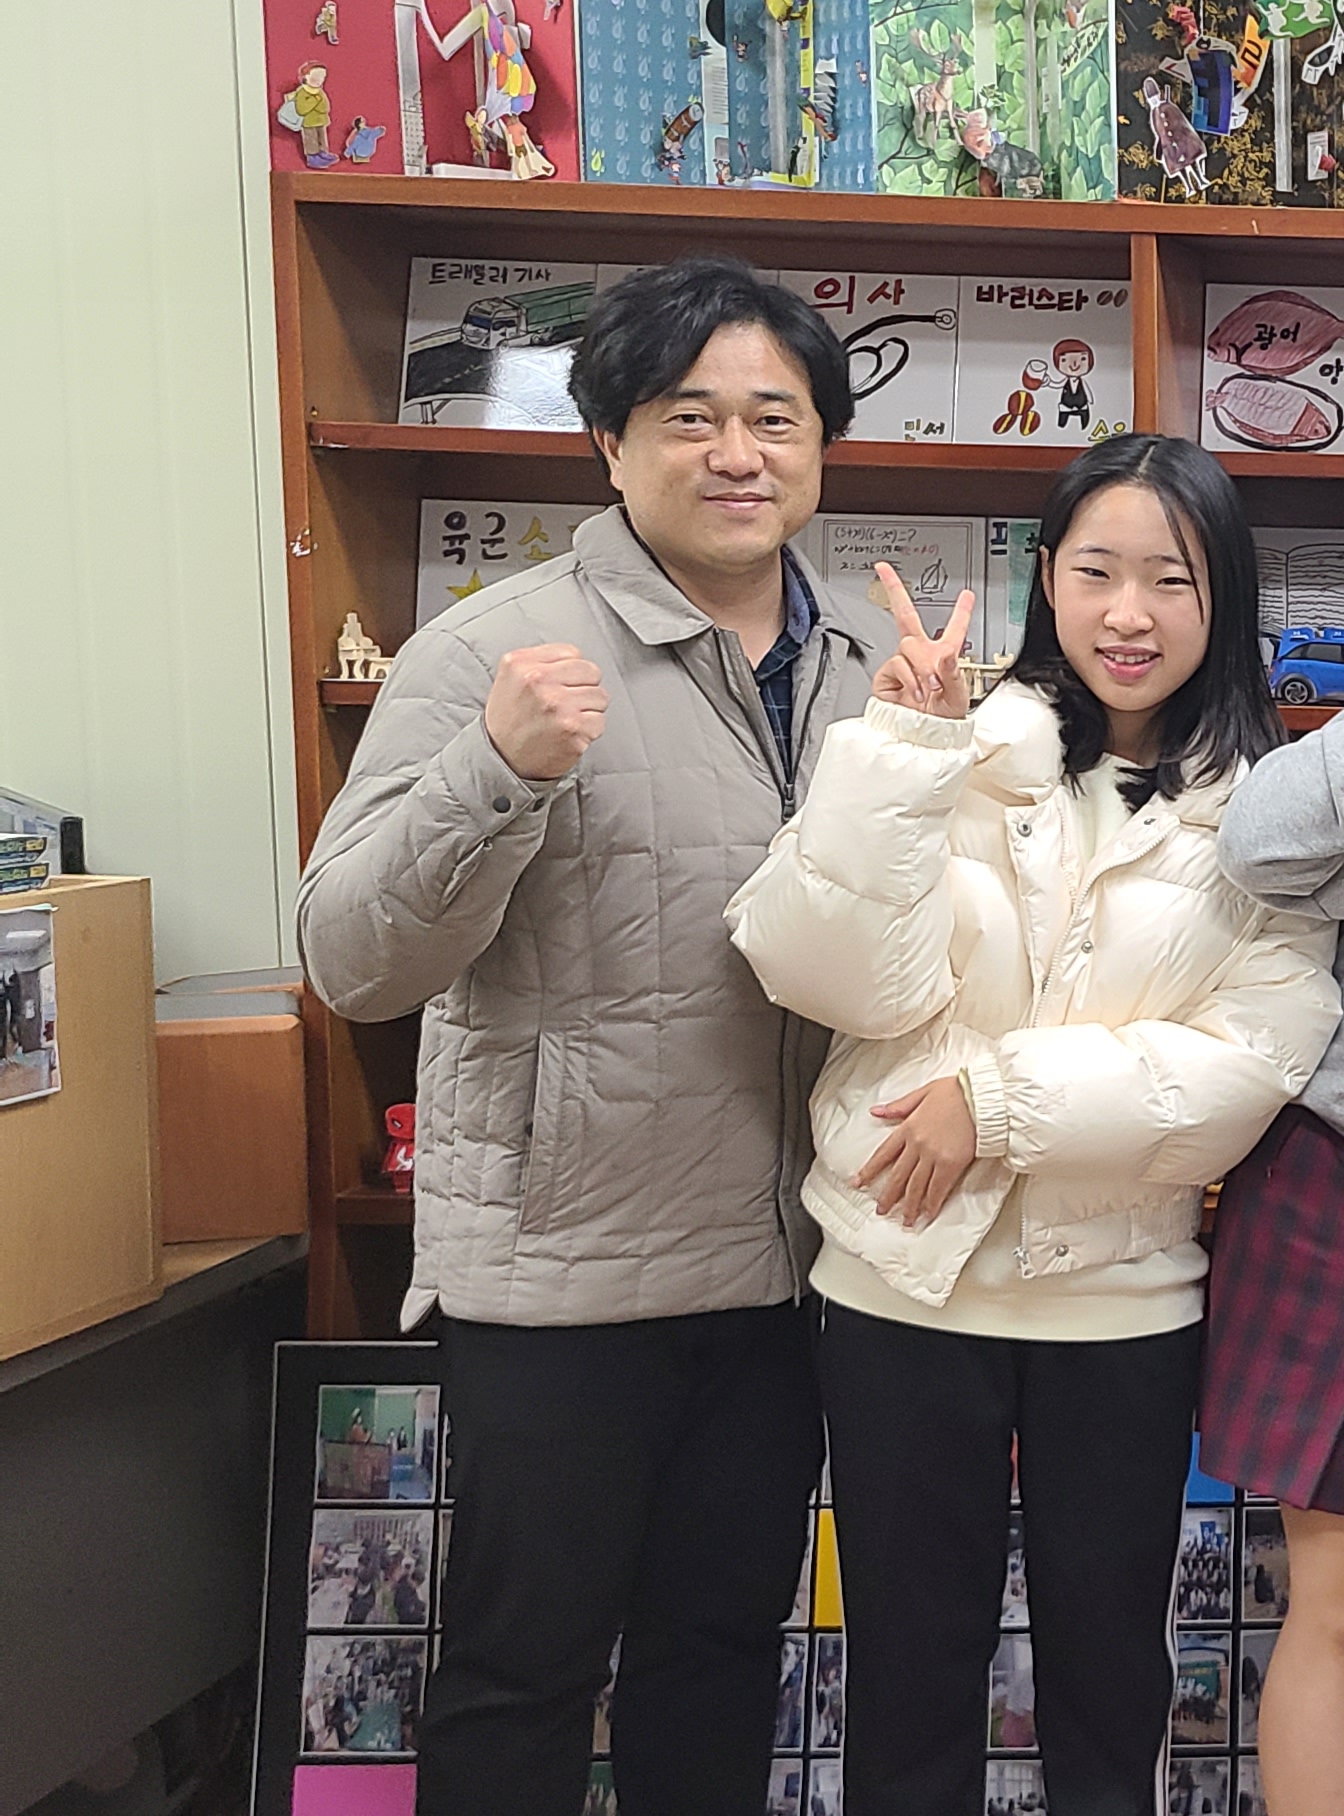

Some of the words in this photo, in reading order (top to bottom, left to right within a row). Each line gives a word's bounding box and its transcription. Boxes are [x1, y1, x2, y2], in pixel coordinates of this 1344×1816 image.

[514, 267, 552, 283] 기사
[813, 274, 905, 315] 의사
[975, 284, 1089, 313] 바리스타
[442, 511, 508, 566] 육군
